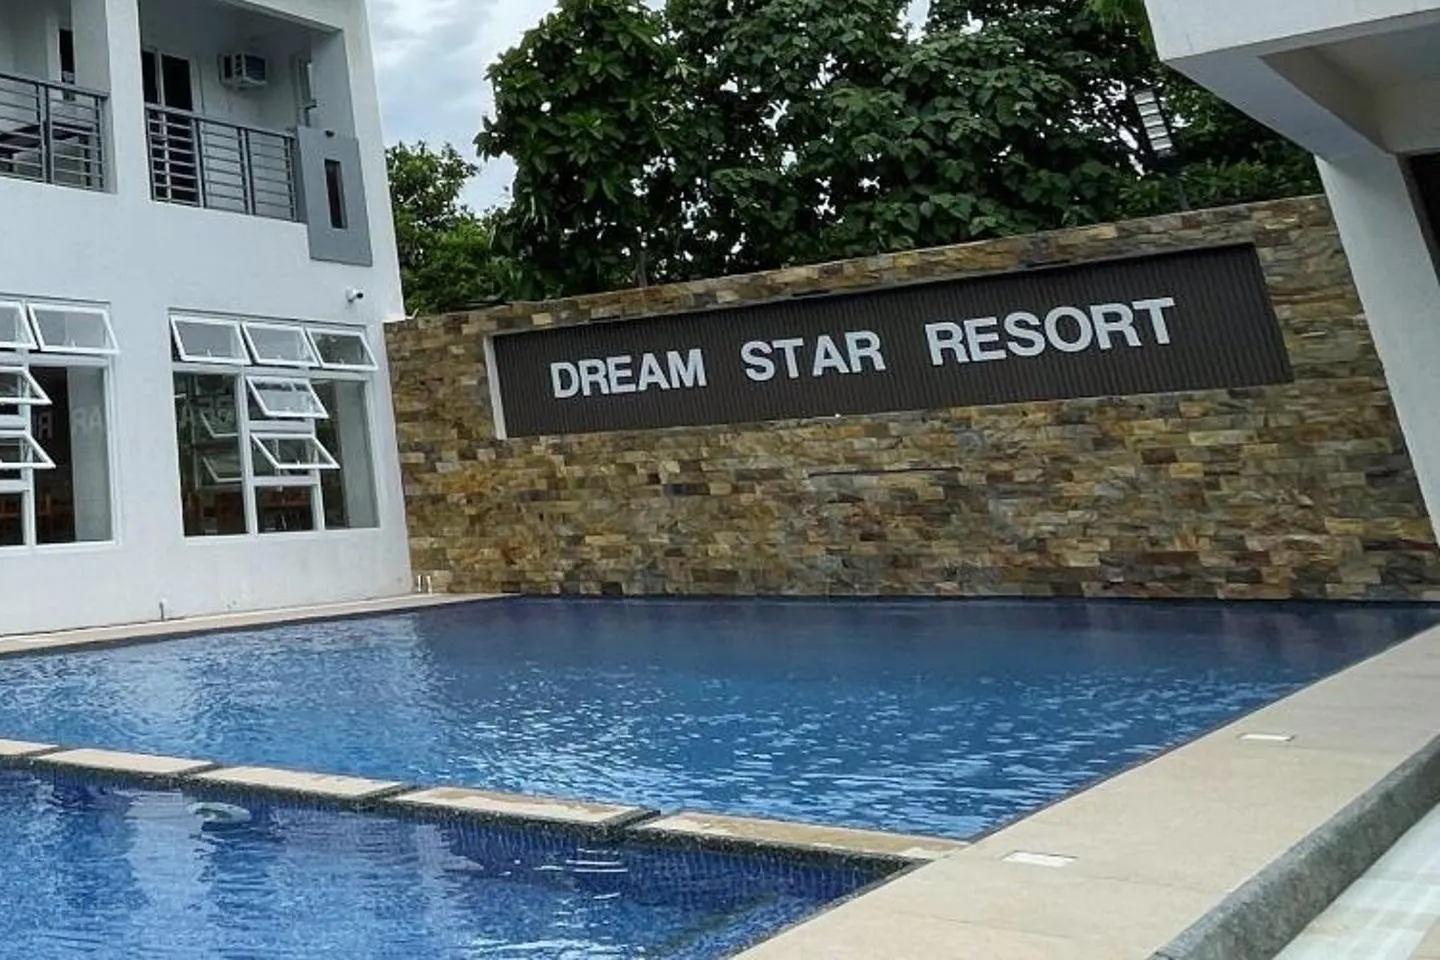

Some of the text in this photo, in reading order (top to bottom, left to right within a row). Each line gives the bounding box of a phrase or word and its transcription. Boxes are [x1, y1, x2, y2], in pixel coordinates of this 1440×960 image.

[550, 297, 1175, 399] DREAM STAR RESORT
